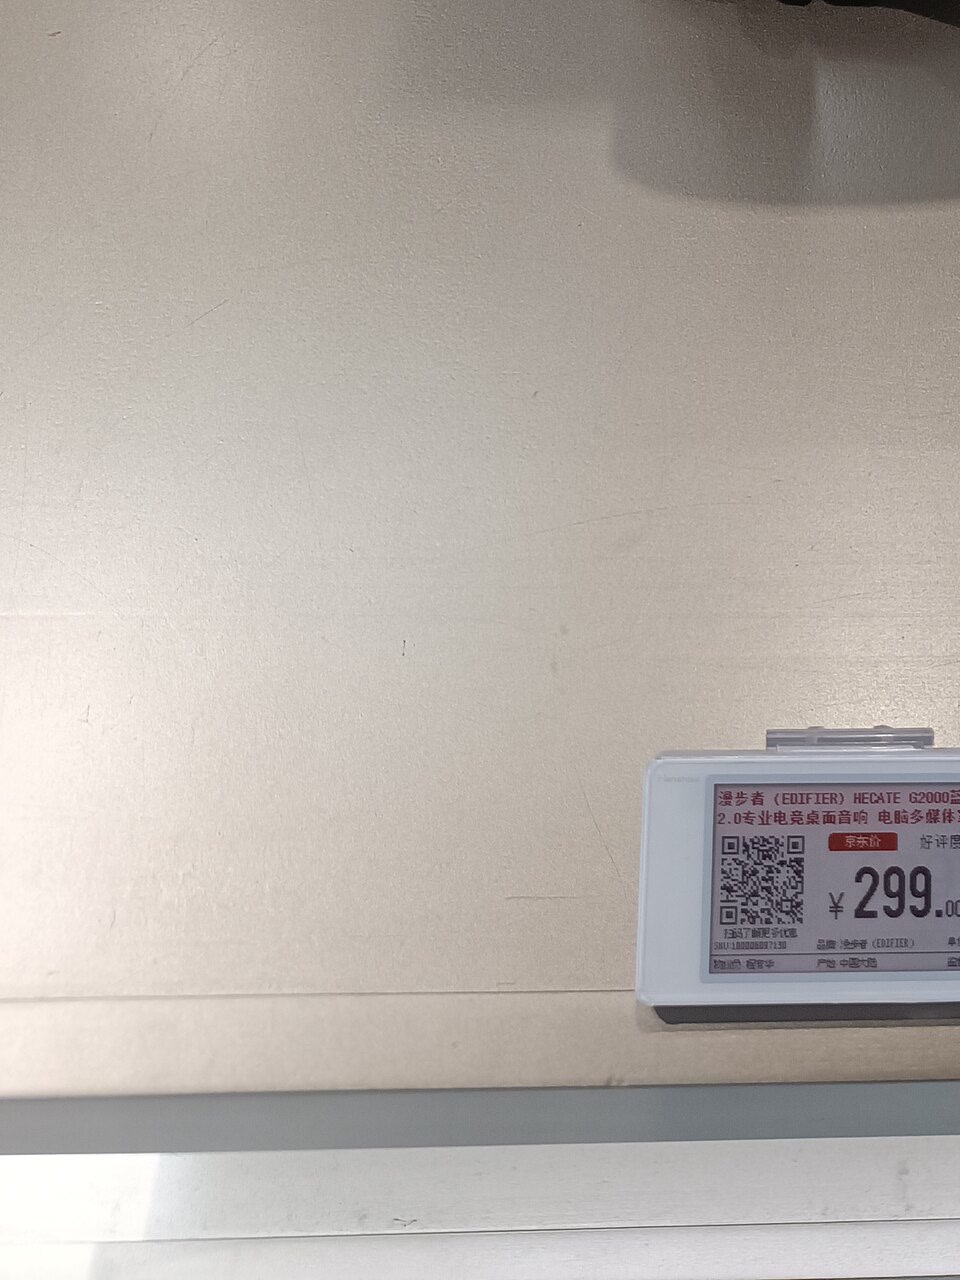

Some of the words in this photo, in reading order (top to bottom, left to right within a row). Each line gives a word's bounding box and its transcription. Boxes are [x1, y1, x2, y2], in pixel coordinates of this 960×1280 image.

[717, 790, 765, 806] 漫步者
[853, 791, 901, 805] HECATE
[717, 809, 868, 825] 2.0专业电竞桌面音响
[844, 835, 882, 847] 京东价
